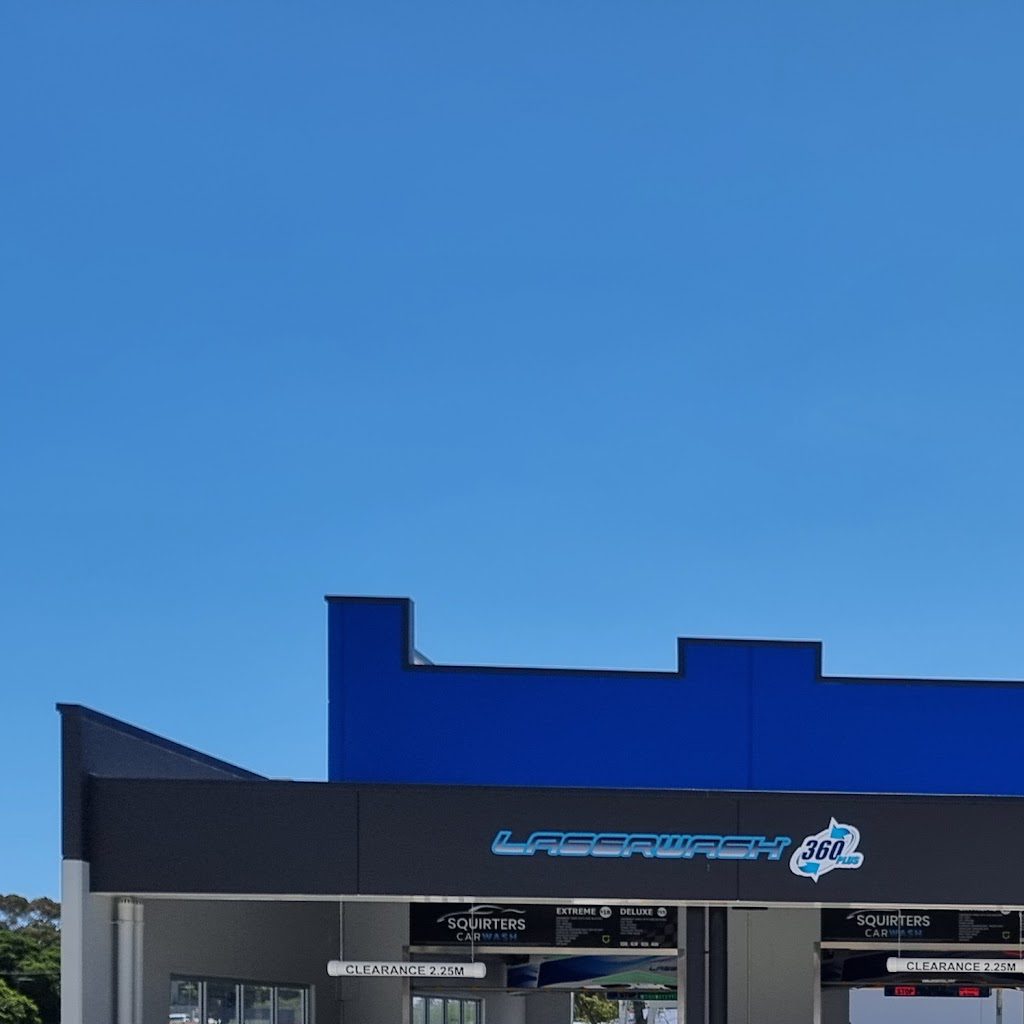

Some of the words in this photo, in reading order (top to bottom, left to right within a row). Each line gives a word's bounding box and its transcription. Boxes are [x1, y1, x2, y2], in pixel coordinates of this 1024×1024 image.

[491, 830, 791, 861] LASERWASH
[802, 840, 845, 860] 360
[835, 856, 861, 865] PLUS
[556, 907, 596, 916] EXTREME
[620, 908, 653, 916] DELUXE
[448, 917, 526, 931] SQUIRTERS
[856, 915, 931, 928] SQUIRTERS
[346, 965, 426, 976] CLEARANCE
[430, 966, 465, 976] 2.25M
[906, 961, 980, 971] CLEARANCE
[983, 962, 1016, 972] 2.25M
